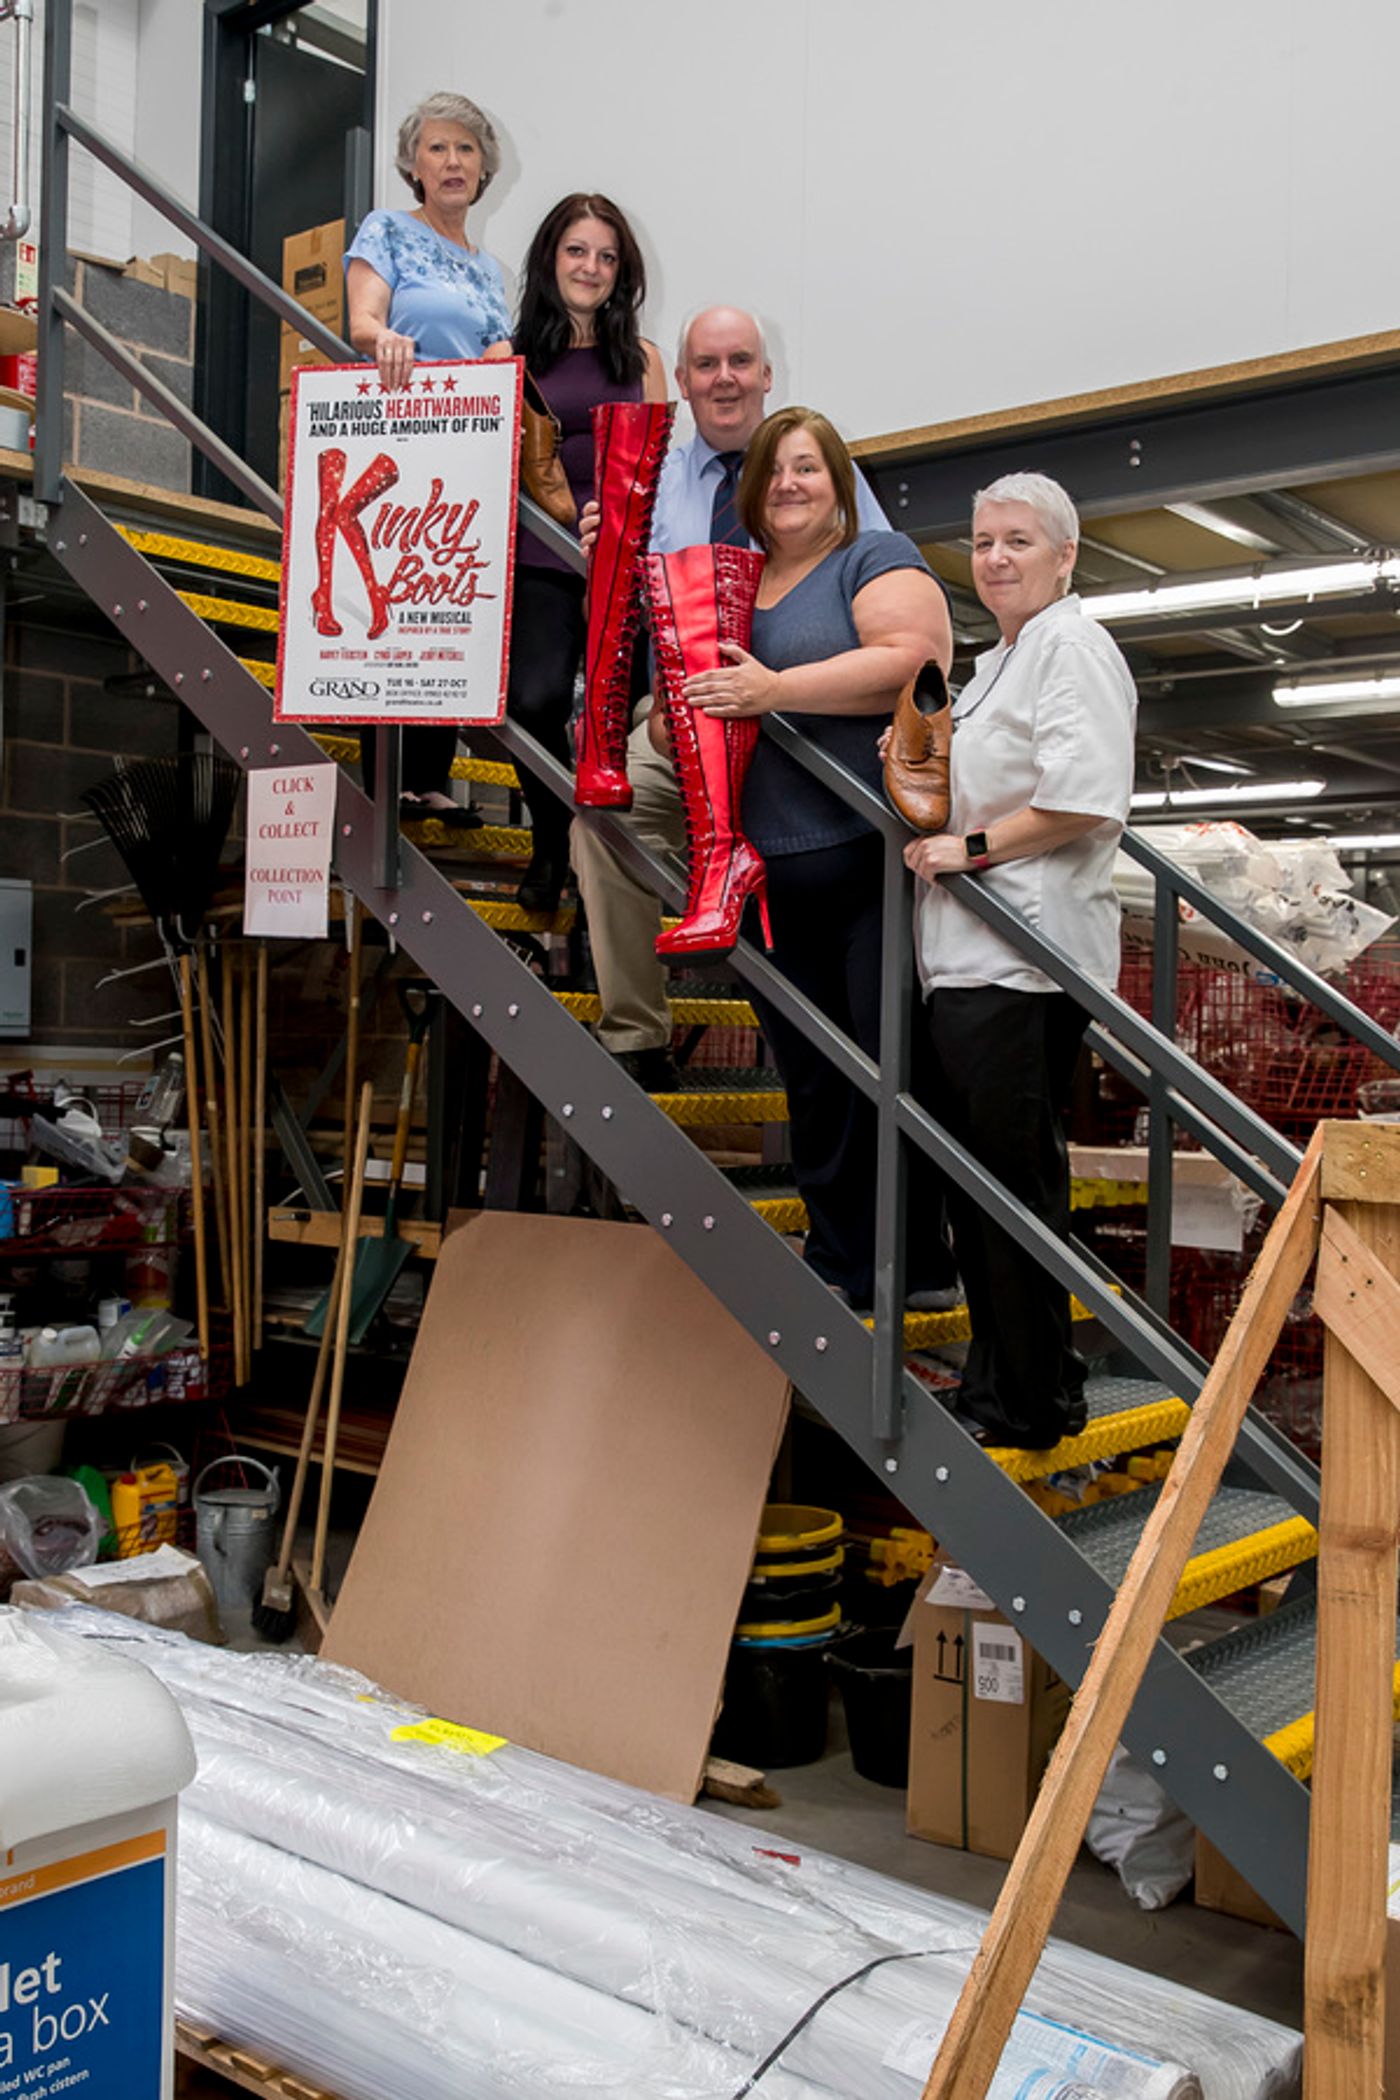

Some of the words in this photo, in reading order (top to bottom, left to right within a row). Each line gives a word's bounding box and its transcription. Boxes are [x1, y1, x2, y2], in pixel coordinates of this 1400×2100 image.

[386, 395, 501, 418] HEARTWARMING
[309, 422, 337, 437] AND
[339, 422, 349, 436] A
[350, 421, 388, 436] HUGE
[389, 419, 449, 435] AMOUNT
[451, 418, 469, 433] OF
[311, 448, 481, 641] Kinky
[384, 553, 498, 607] Boots
[399, 611, 405, 623] A
[407, 611, 428, 623] NEW
[430, 611, 472, 623] MUSICAL
[308, 681, 380, 700] GRAND
[387, 678, 402, 688] TUE
[420, 678, 435, 688] SAT
[272, 777, 314, 794] CLICK
[284, 801, 295, 815] &
[259, 822, 319, 839] COLLECT
[250, 868, 324, 883] COLLECTION
[268, 889, 302, 904] POINT
[33, 1992, 110, 2054] box
[23, 2064, 45, 2084] WC
[47, 2057, 71, 2077] pan
[49, 2069, 90, 2094] cistern
